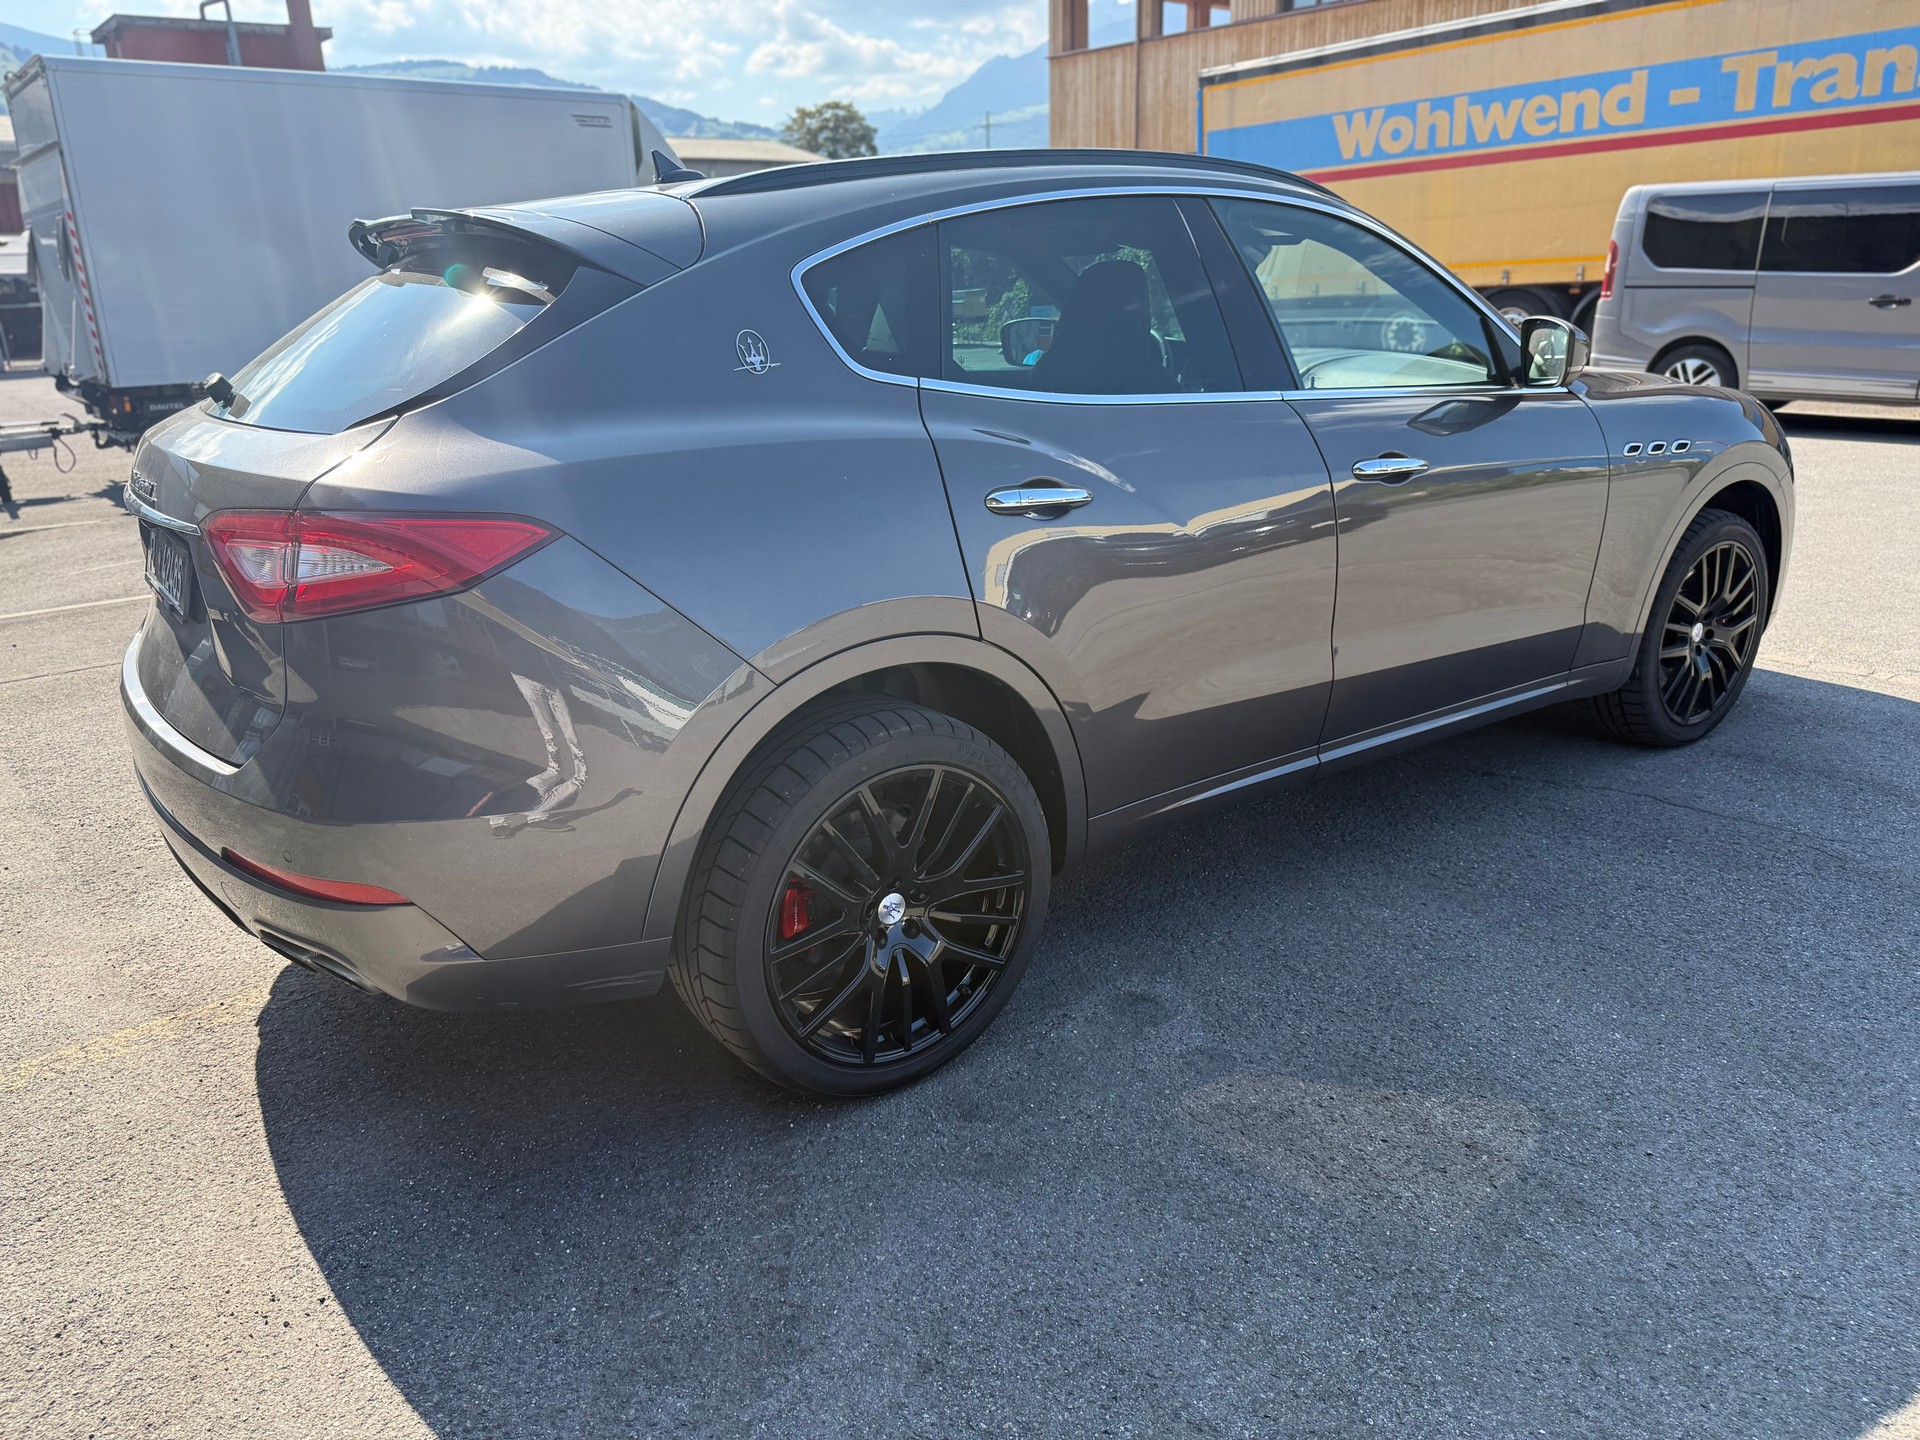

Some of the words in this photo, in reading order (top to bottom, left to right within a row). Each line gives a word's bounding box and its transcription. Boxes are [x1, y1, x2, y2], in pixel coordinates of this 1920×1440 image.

[1332, 69, 1649, 160] Wohlwend
[1721, 44, 1920, 112] Tran
[149, 402, 185, 411] DAUTEL
